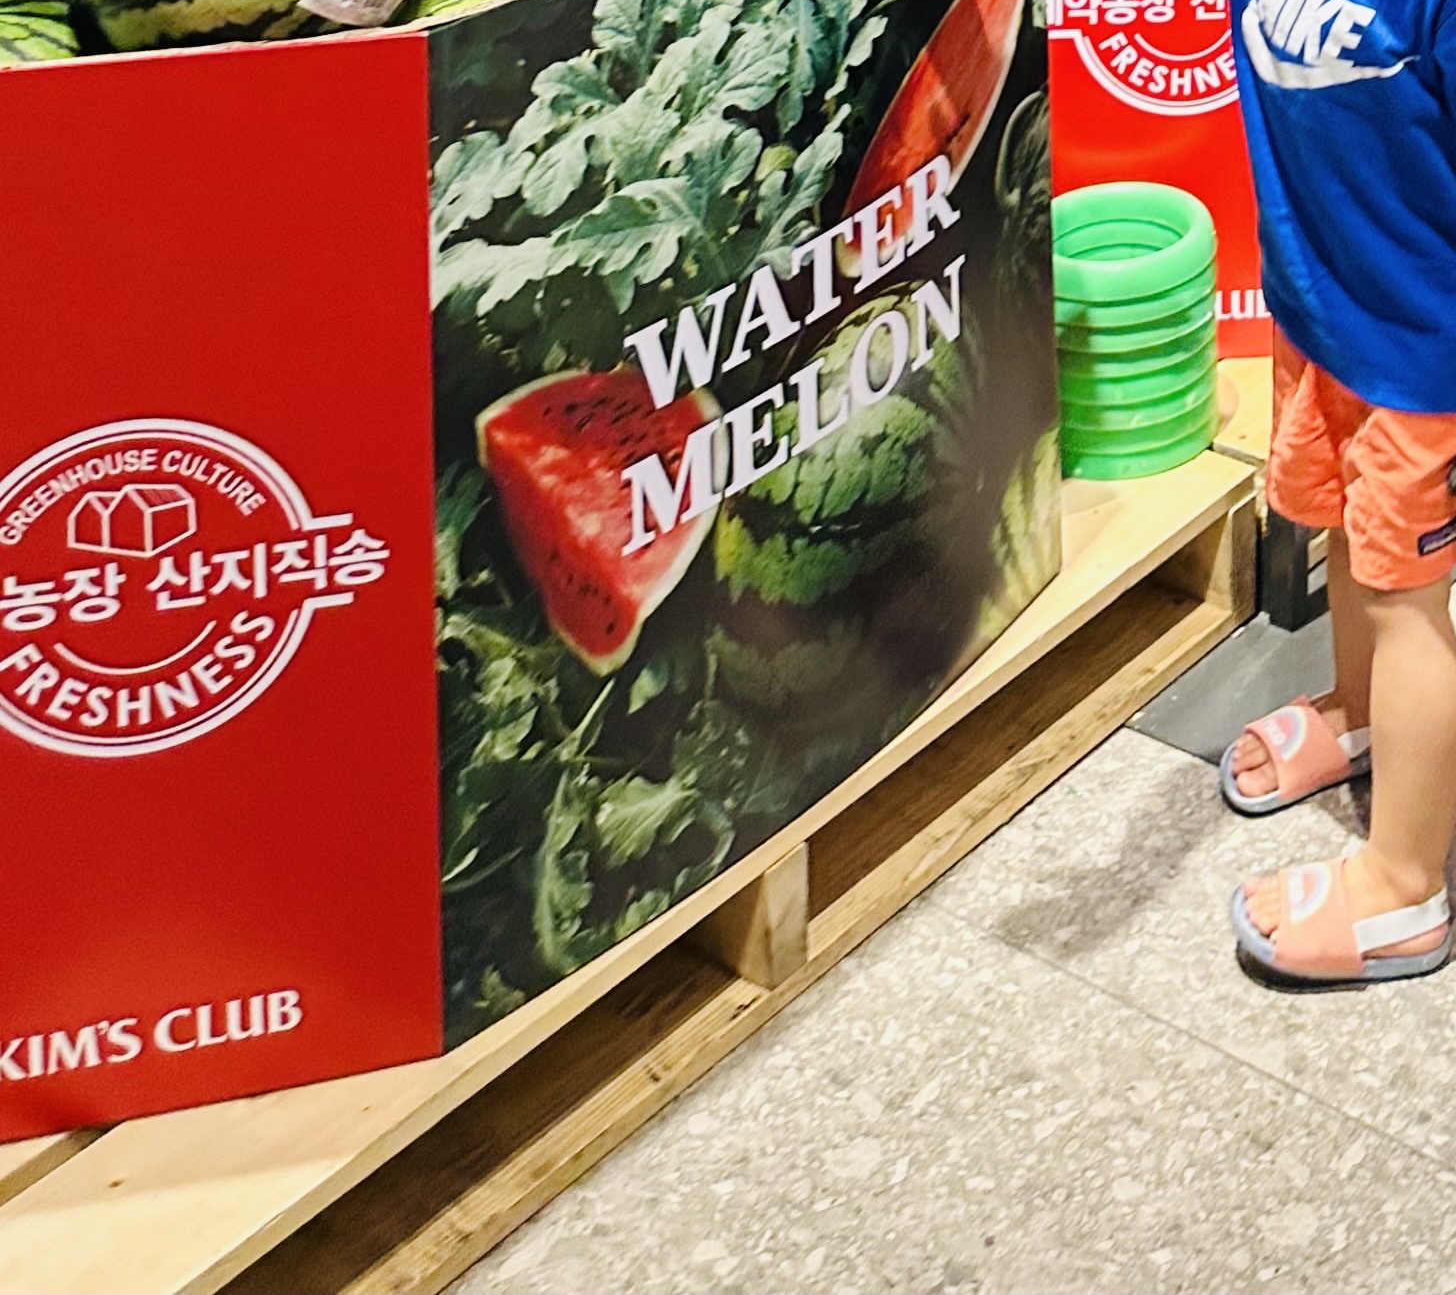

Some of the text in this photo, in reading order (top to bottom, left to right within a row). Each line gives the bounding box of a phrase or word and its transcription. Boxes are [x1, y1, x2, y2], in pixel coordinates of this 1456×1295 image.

[624, 154, 963, 410] WATER
[621, 253, 967, 557] MELON
[0, 448, 267, 545] GREENHOUSE CULTURE
[146, 529, 391, 612] 산지직송
[0, 610, 276, 729] FRESHNESS
[0, 988, 304, 1082] KIM'S CLUB
